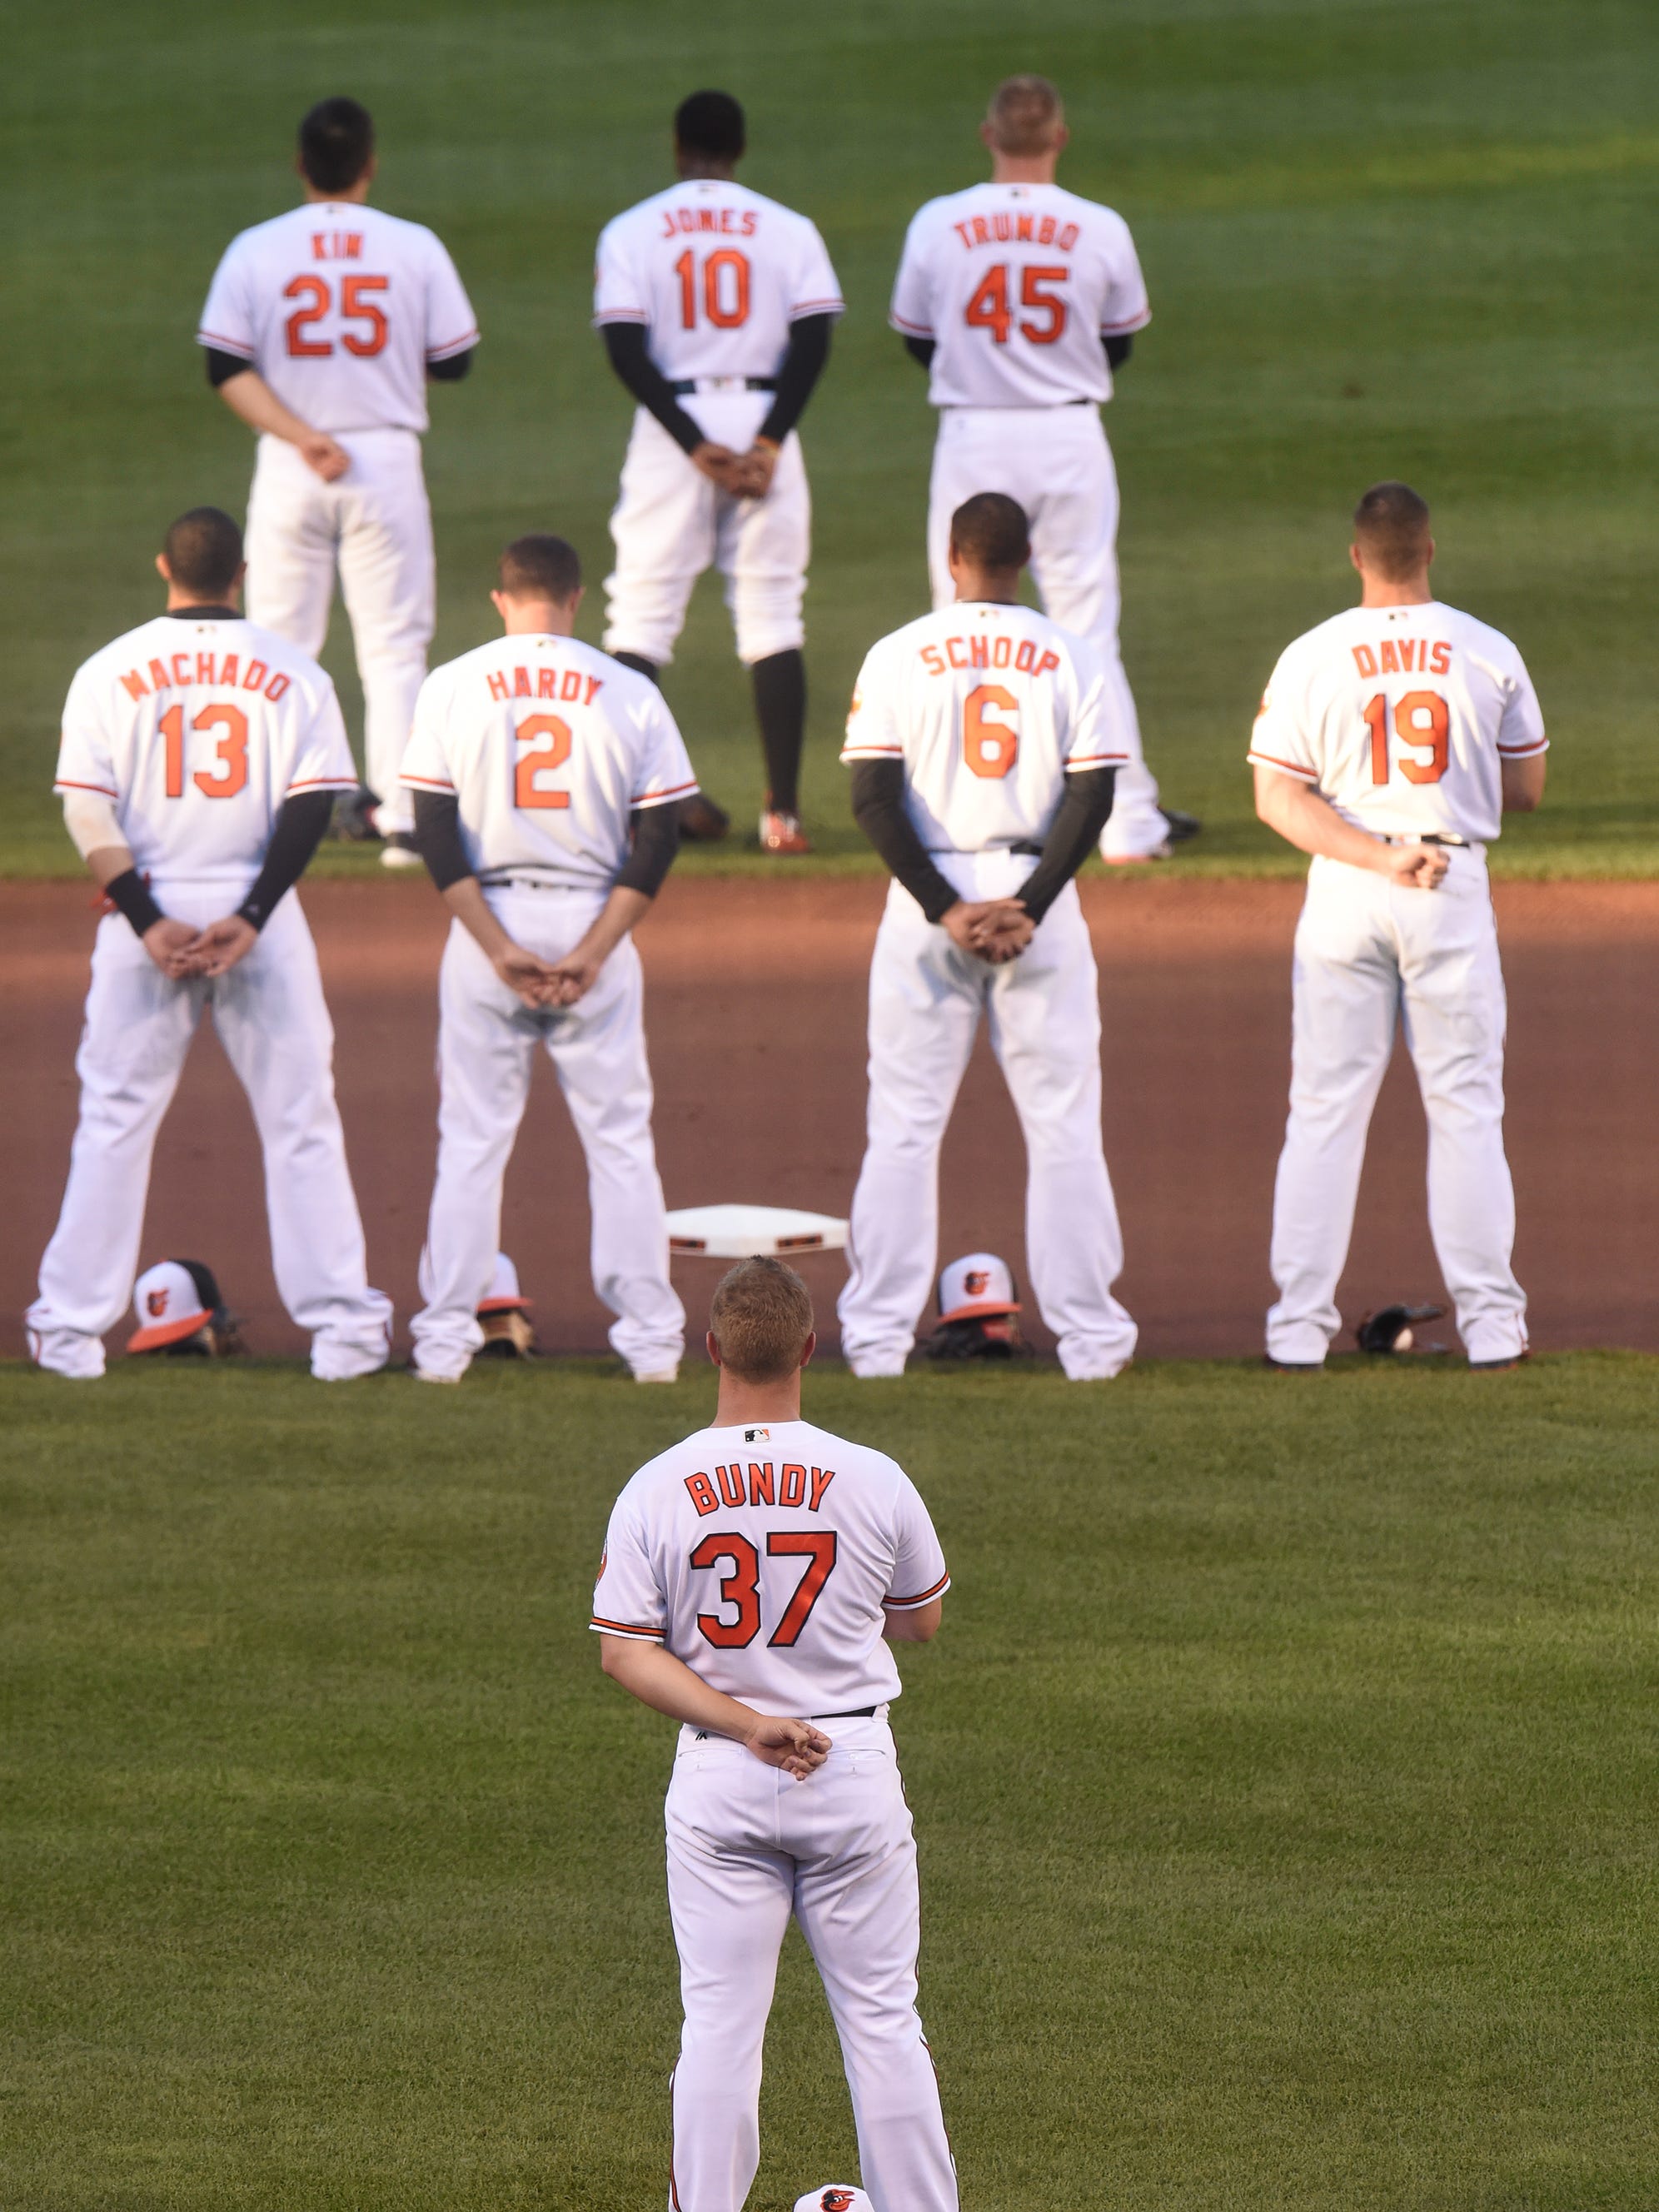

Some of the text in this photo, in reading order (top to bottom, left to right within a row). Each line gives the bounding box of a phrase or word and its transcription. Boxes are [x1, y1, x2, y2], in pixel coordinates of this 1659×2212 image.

[311, 232, 364, 261] KIM
[662, 207, 757, 238] JONES
[954, 213, 1079, 252] TRUMBO
[283, 274, 389, 358] 25
[674, 247, 751, 331] 10
[964, 262, 1069, 345] 45
[119, 652, 291, 703] MACHADO
[486, 665, 603, 705] HARDY
[920, 635, 1060, 676] SCHOOP
[1352, 639, 1452, 679] DAVIS
[158, 704, 248, 798] 13
[514, 713, 572, 809] 2
[964, 683, 1019, 779] 6
[1363, 690, 1449, 785] 19
[684, 1462, 835, 1517] BUNDY
[690, 1531, 837, 1649] 37
